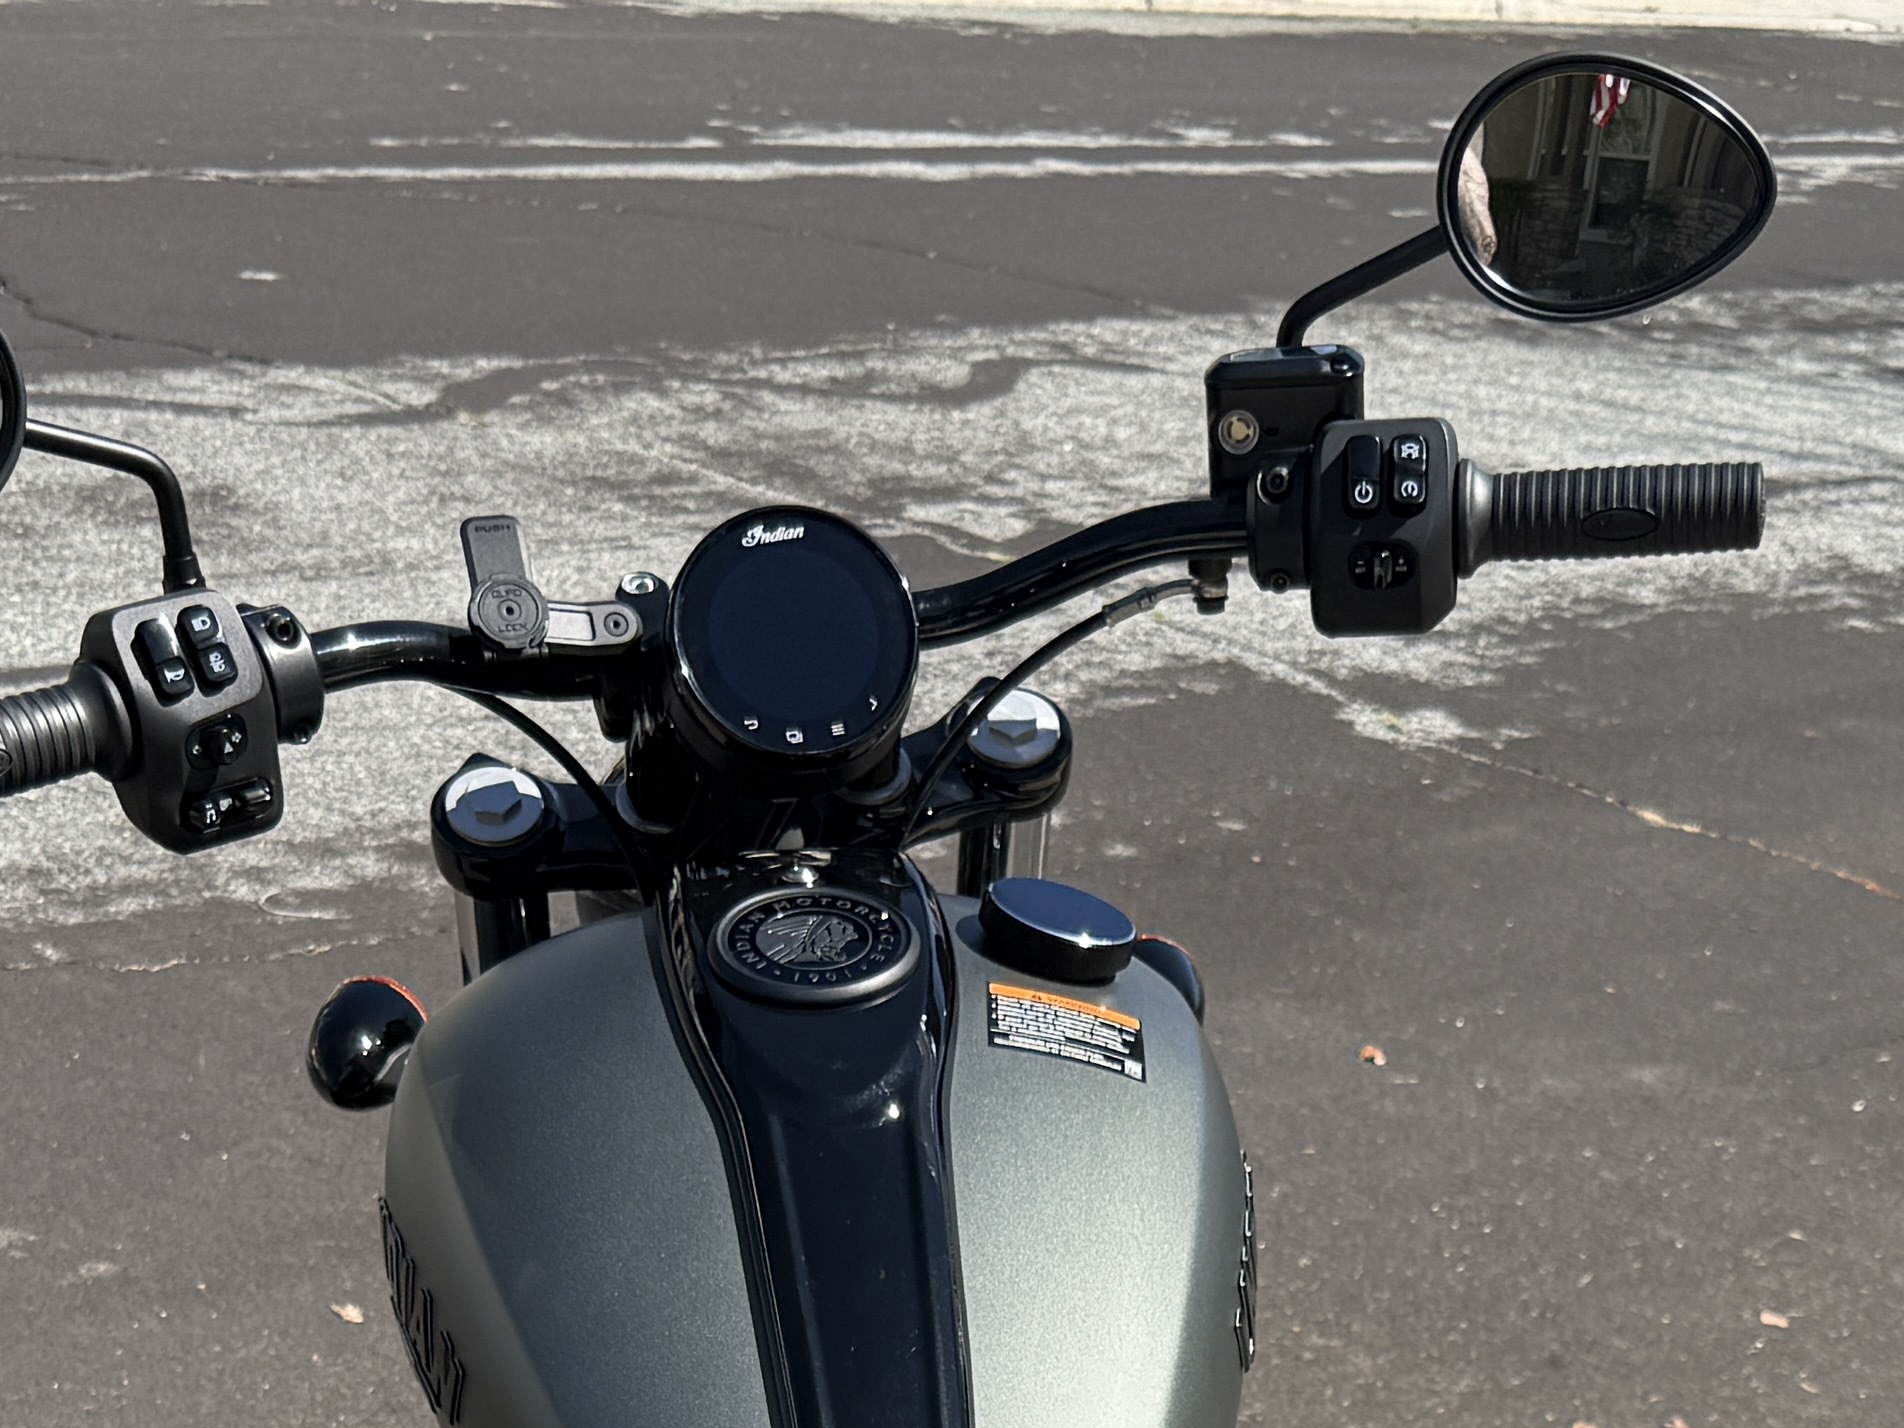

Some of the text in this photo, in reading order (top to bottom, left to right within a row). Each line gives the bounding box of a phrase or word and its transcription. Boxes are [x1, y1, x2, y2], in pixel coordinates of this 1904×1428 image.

[474, 525, 512, 533] PUSH
[741, 524, 805, 548] Indian
[491, 588, 522, 599] QUAD
[497, 622, 528, 633] LOCK
[735, 897, 895, 970] INDIAN MOTORCYCLE
[793, 969, 852, 983] 1901
